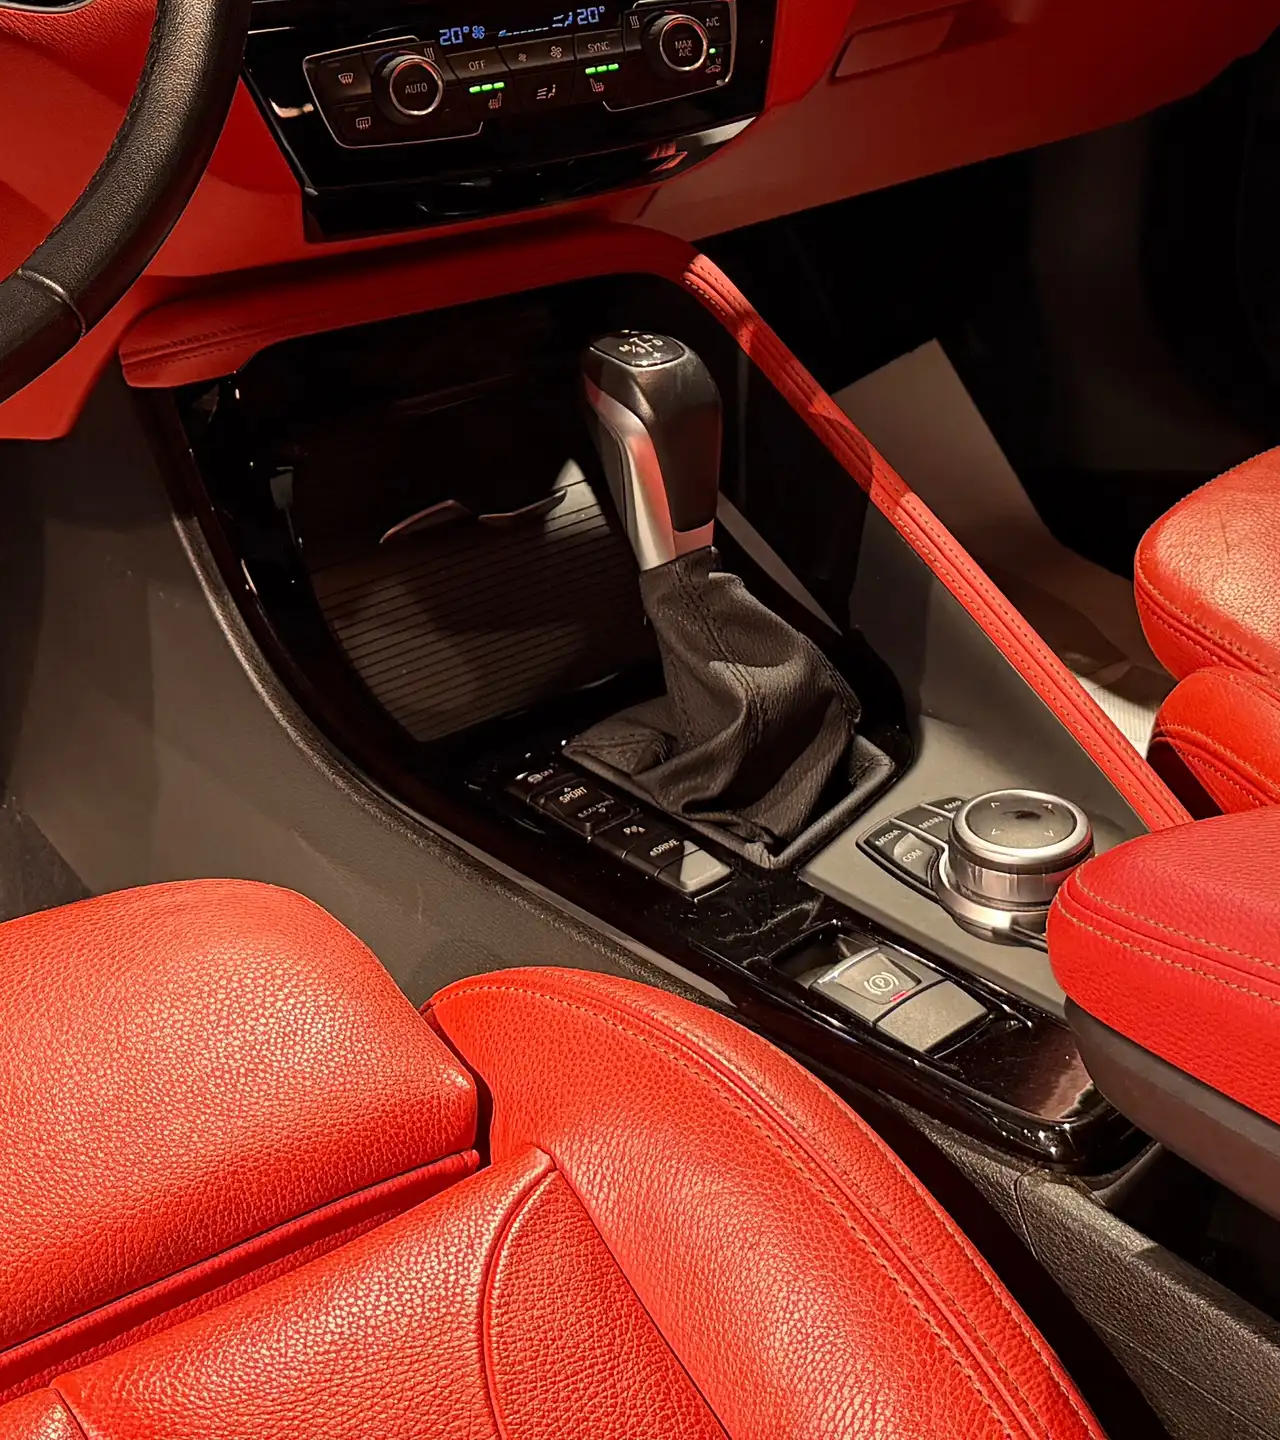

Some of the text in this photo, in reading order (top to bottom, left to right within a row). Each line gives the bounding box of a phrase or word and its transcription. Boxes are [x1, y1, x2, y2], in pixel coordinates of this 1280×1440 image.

[576, 5, 606, 26] 20°
[705, 16, 720, 28] A/C
[439, 25, 470, 46] 20°
[587, 41, 610, 54] SYNC
[675, 39, 693, 50] MAX
[678, 47, 693, 58] A/C
[468, 61, 486, 72] OFF
[405, 82, 428, 94] AUTO
[558, 786, 588, 804] SPORT
[918, 815, 945, 830] MENU
[874, 828, 903, 846] MEDIA
[902, 848, 925, 863] COM
